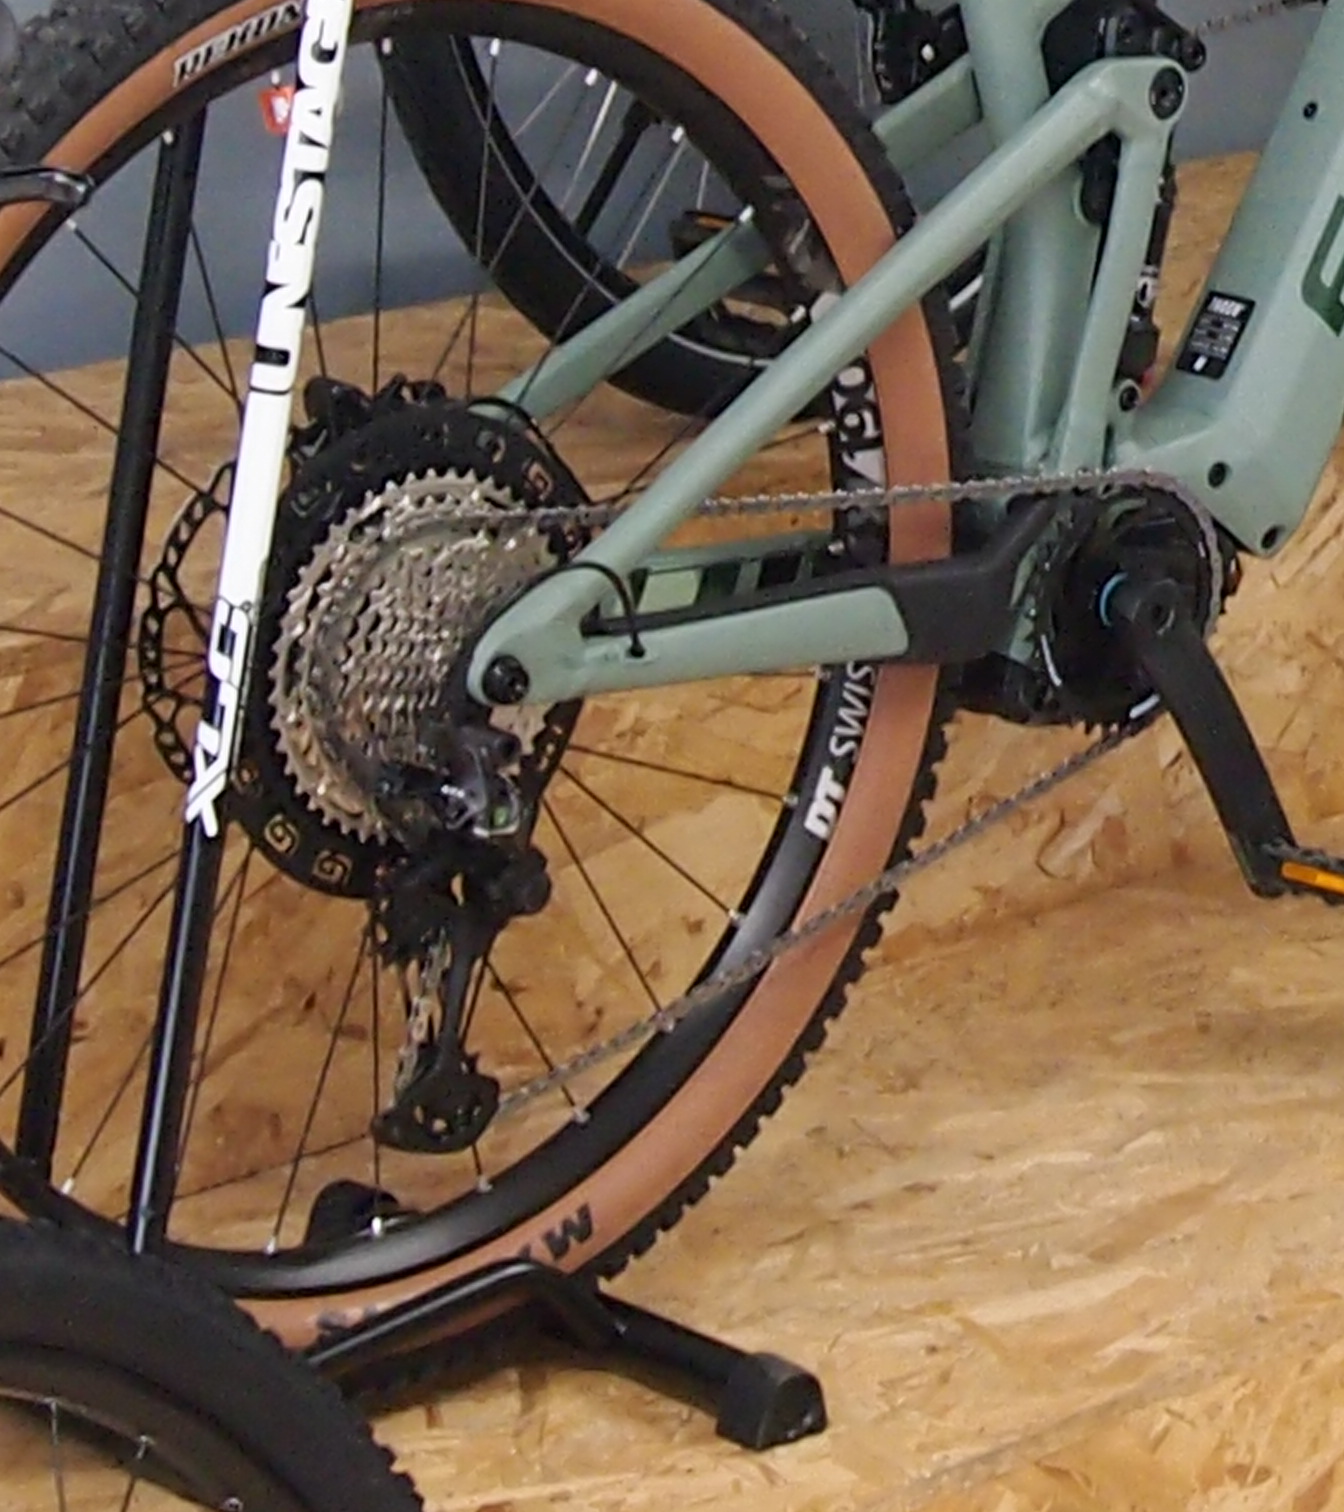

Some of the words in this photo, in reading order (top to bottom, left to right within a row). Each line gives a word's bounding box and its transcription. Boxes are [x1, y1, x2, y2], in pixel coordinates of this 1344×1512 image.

[185, 596, 254, 838] XLC
[803, 765, 847, 842] DT
[828, 659, 876, 763] SWIS
